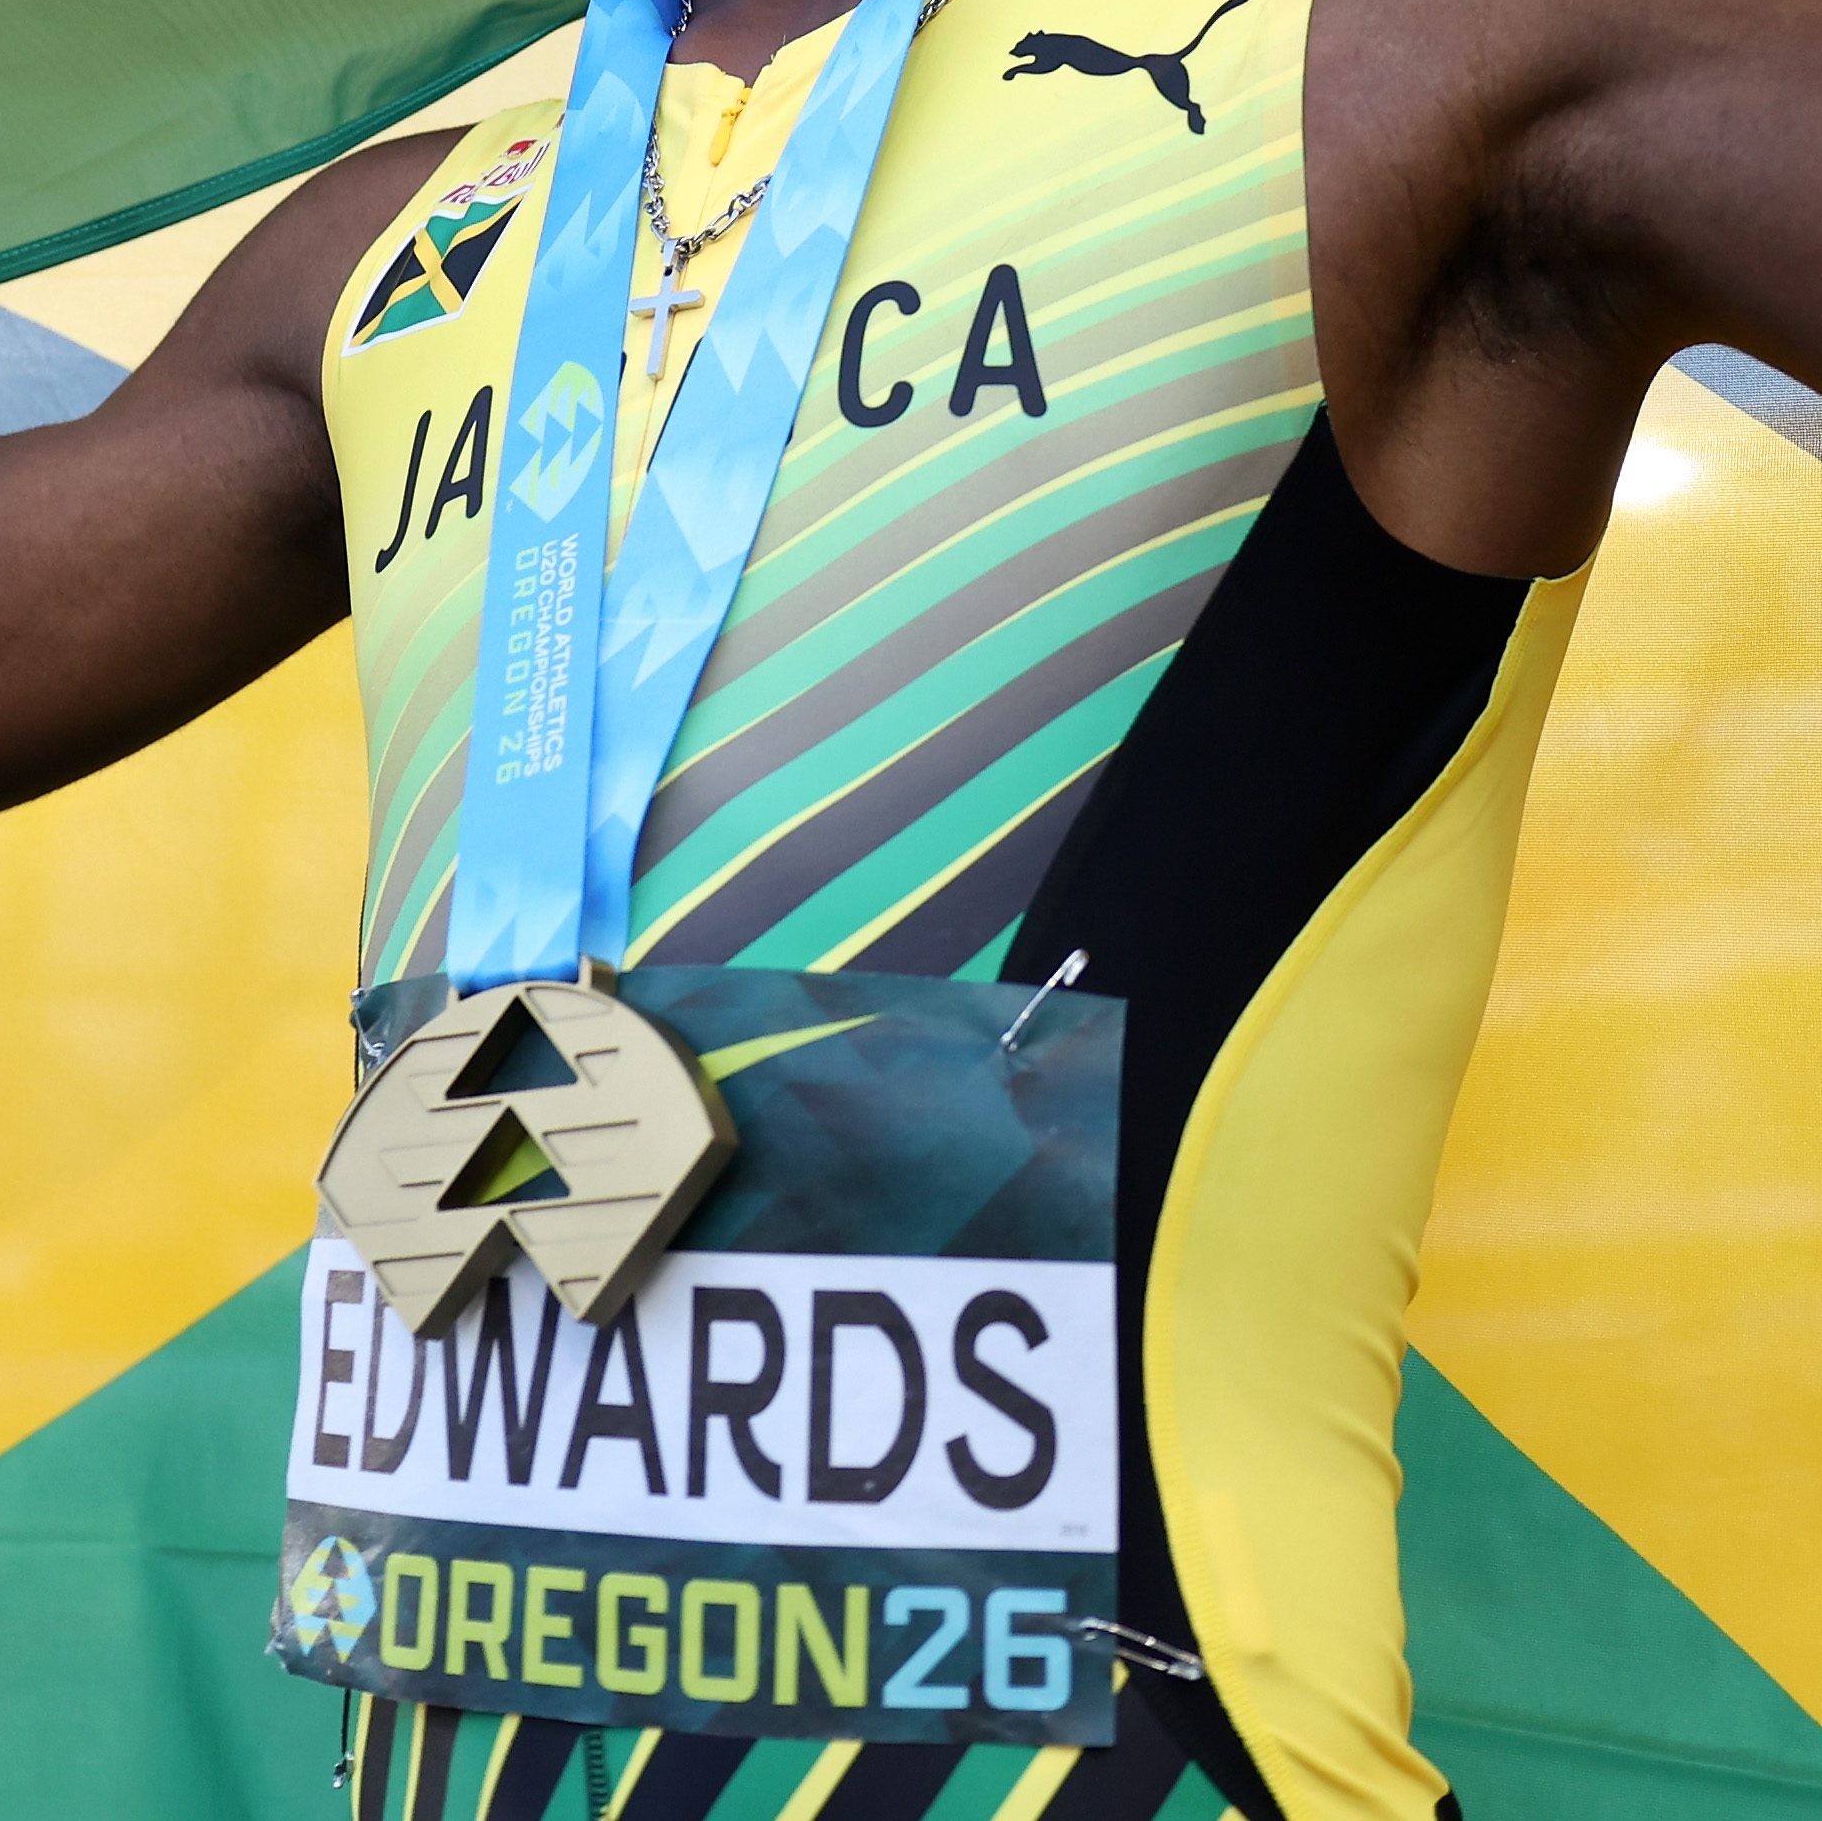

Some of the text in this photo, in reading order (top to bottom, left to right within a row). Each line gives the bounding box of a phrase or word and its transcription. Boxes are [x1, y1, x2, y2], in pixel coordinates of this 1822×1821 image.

[486, 140, 551, 187] Bull
[374, 263, 1048, 574] JACA
[495, 545, 540, 785] OREGON 26
[523, 538, 559, 778] U20 CHAMPIONSHIPS
[543, 531, 580, 773] WORLD ATHLETICS
[312, 1268, 1058, 1510] EDWARDS
[379, 1551, 1071, 1712] OREGON26
